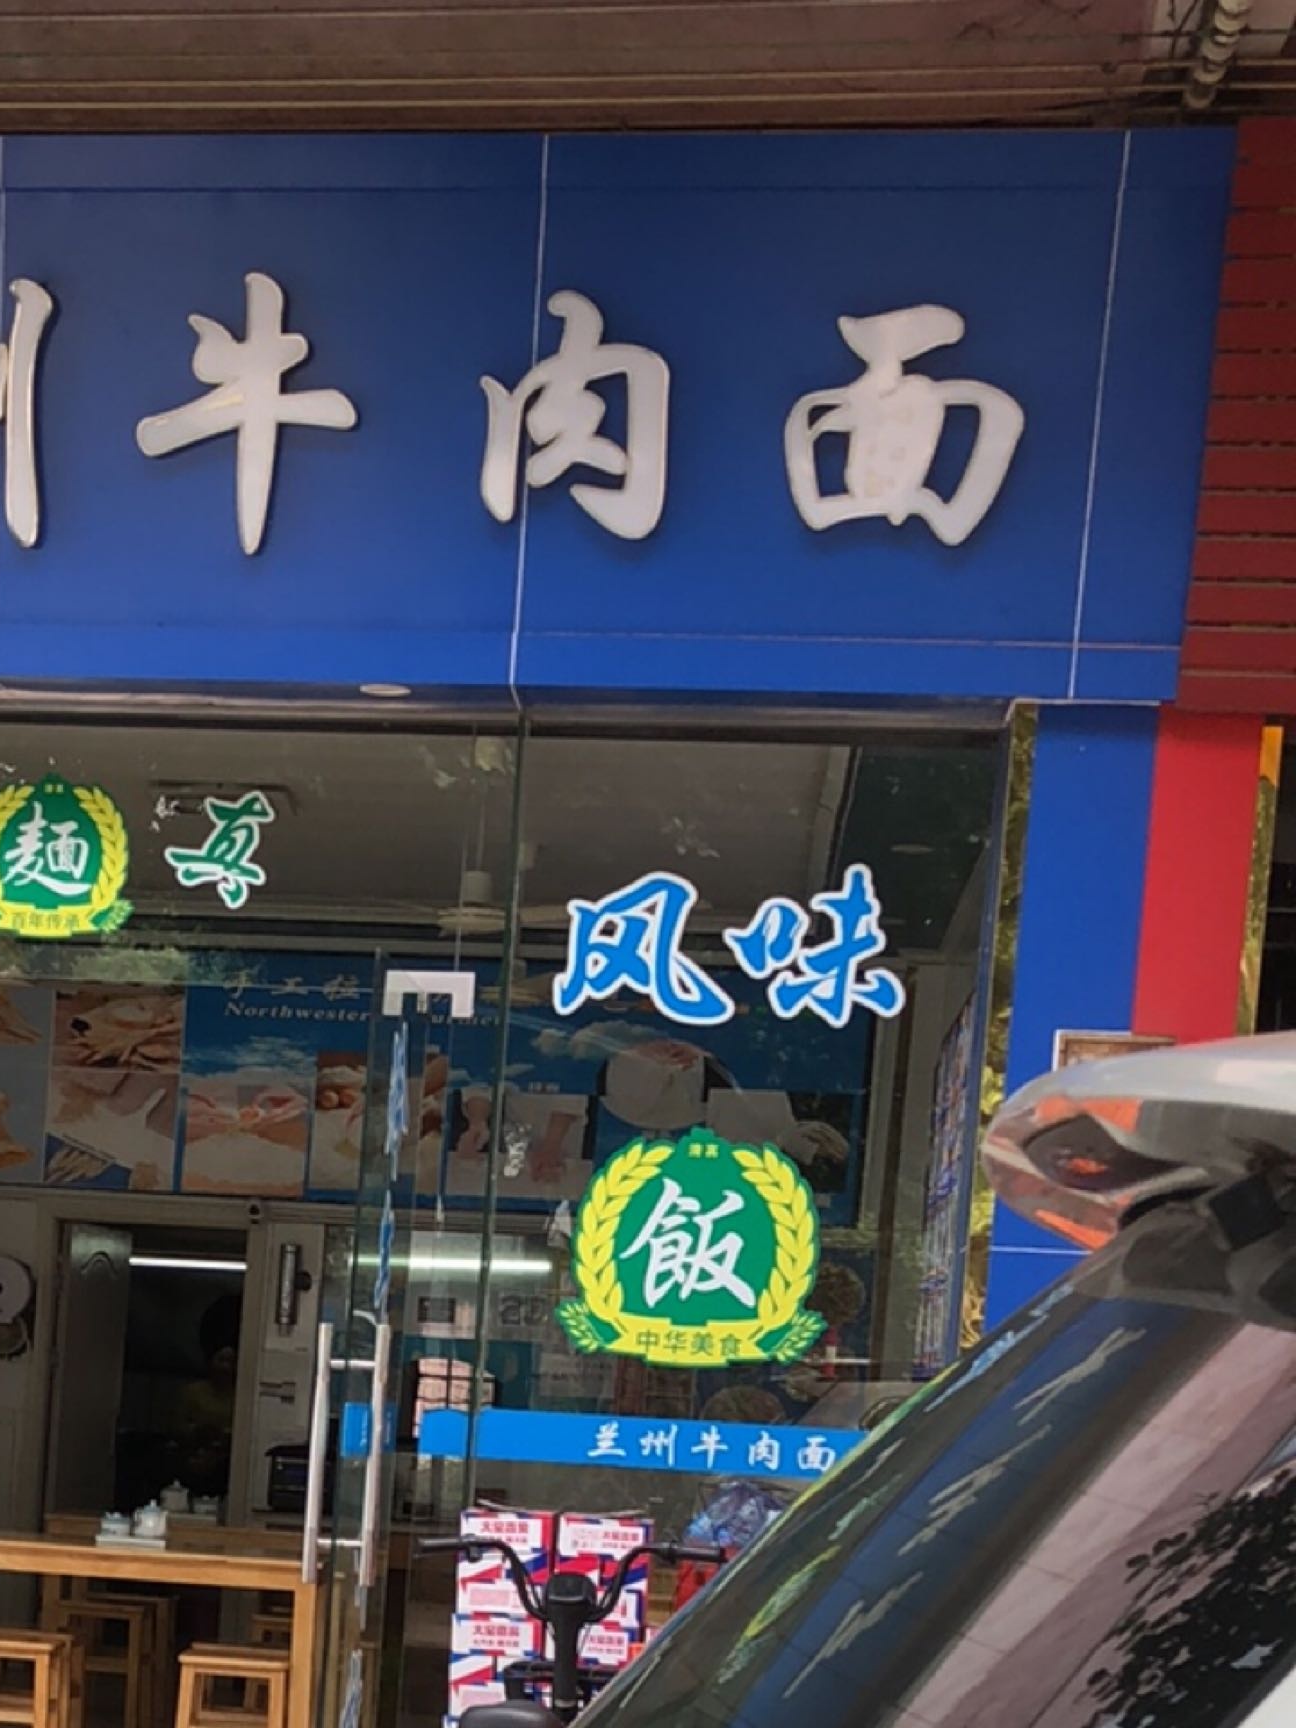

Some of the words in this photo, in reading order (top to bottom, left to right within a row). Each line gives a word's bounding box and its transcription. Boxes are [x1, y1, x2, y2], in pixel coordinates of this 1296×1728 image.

[554, 863, 906, 1028] 风味
[636, 1328, 742, 1357] 中华美食
[587, 1421, 837, 1472] 兰州牛肉面
